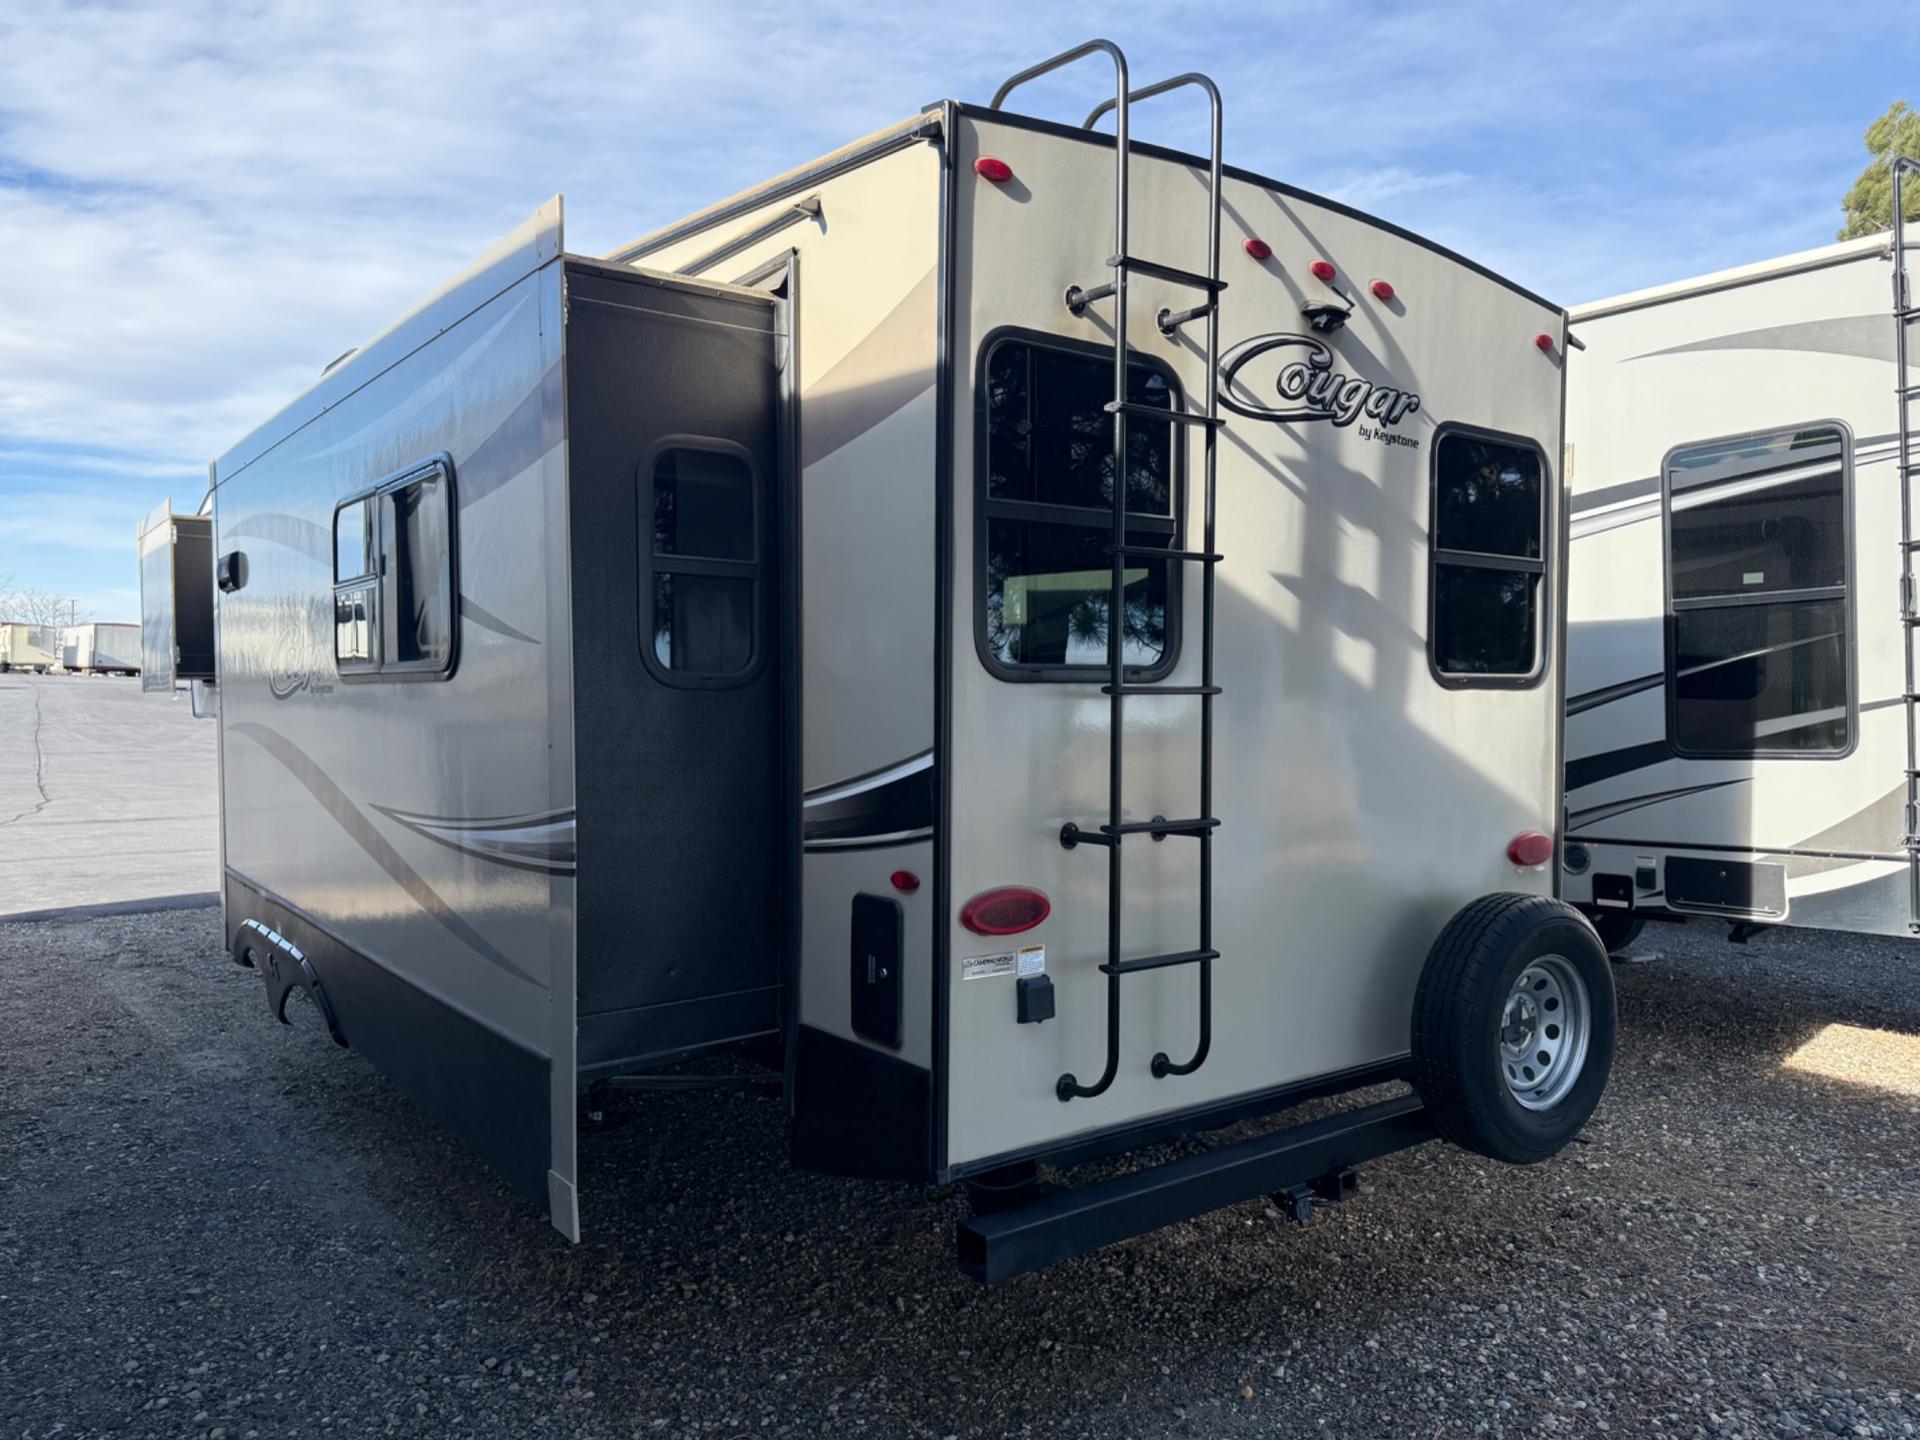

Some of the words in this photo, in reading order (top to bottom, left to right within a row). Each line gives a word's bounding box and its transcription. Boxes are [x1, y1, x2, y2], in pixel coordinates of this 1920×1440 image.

[1216, 332, 1421, 428] Cougar
[1358, 424, 1372, 441] by
[1373, 427, 1420, 449] Keystone
